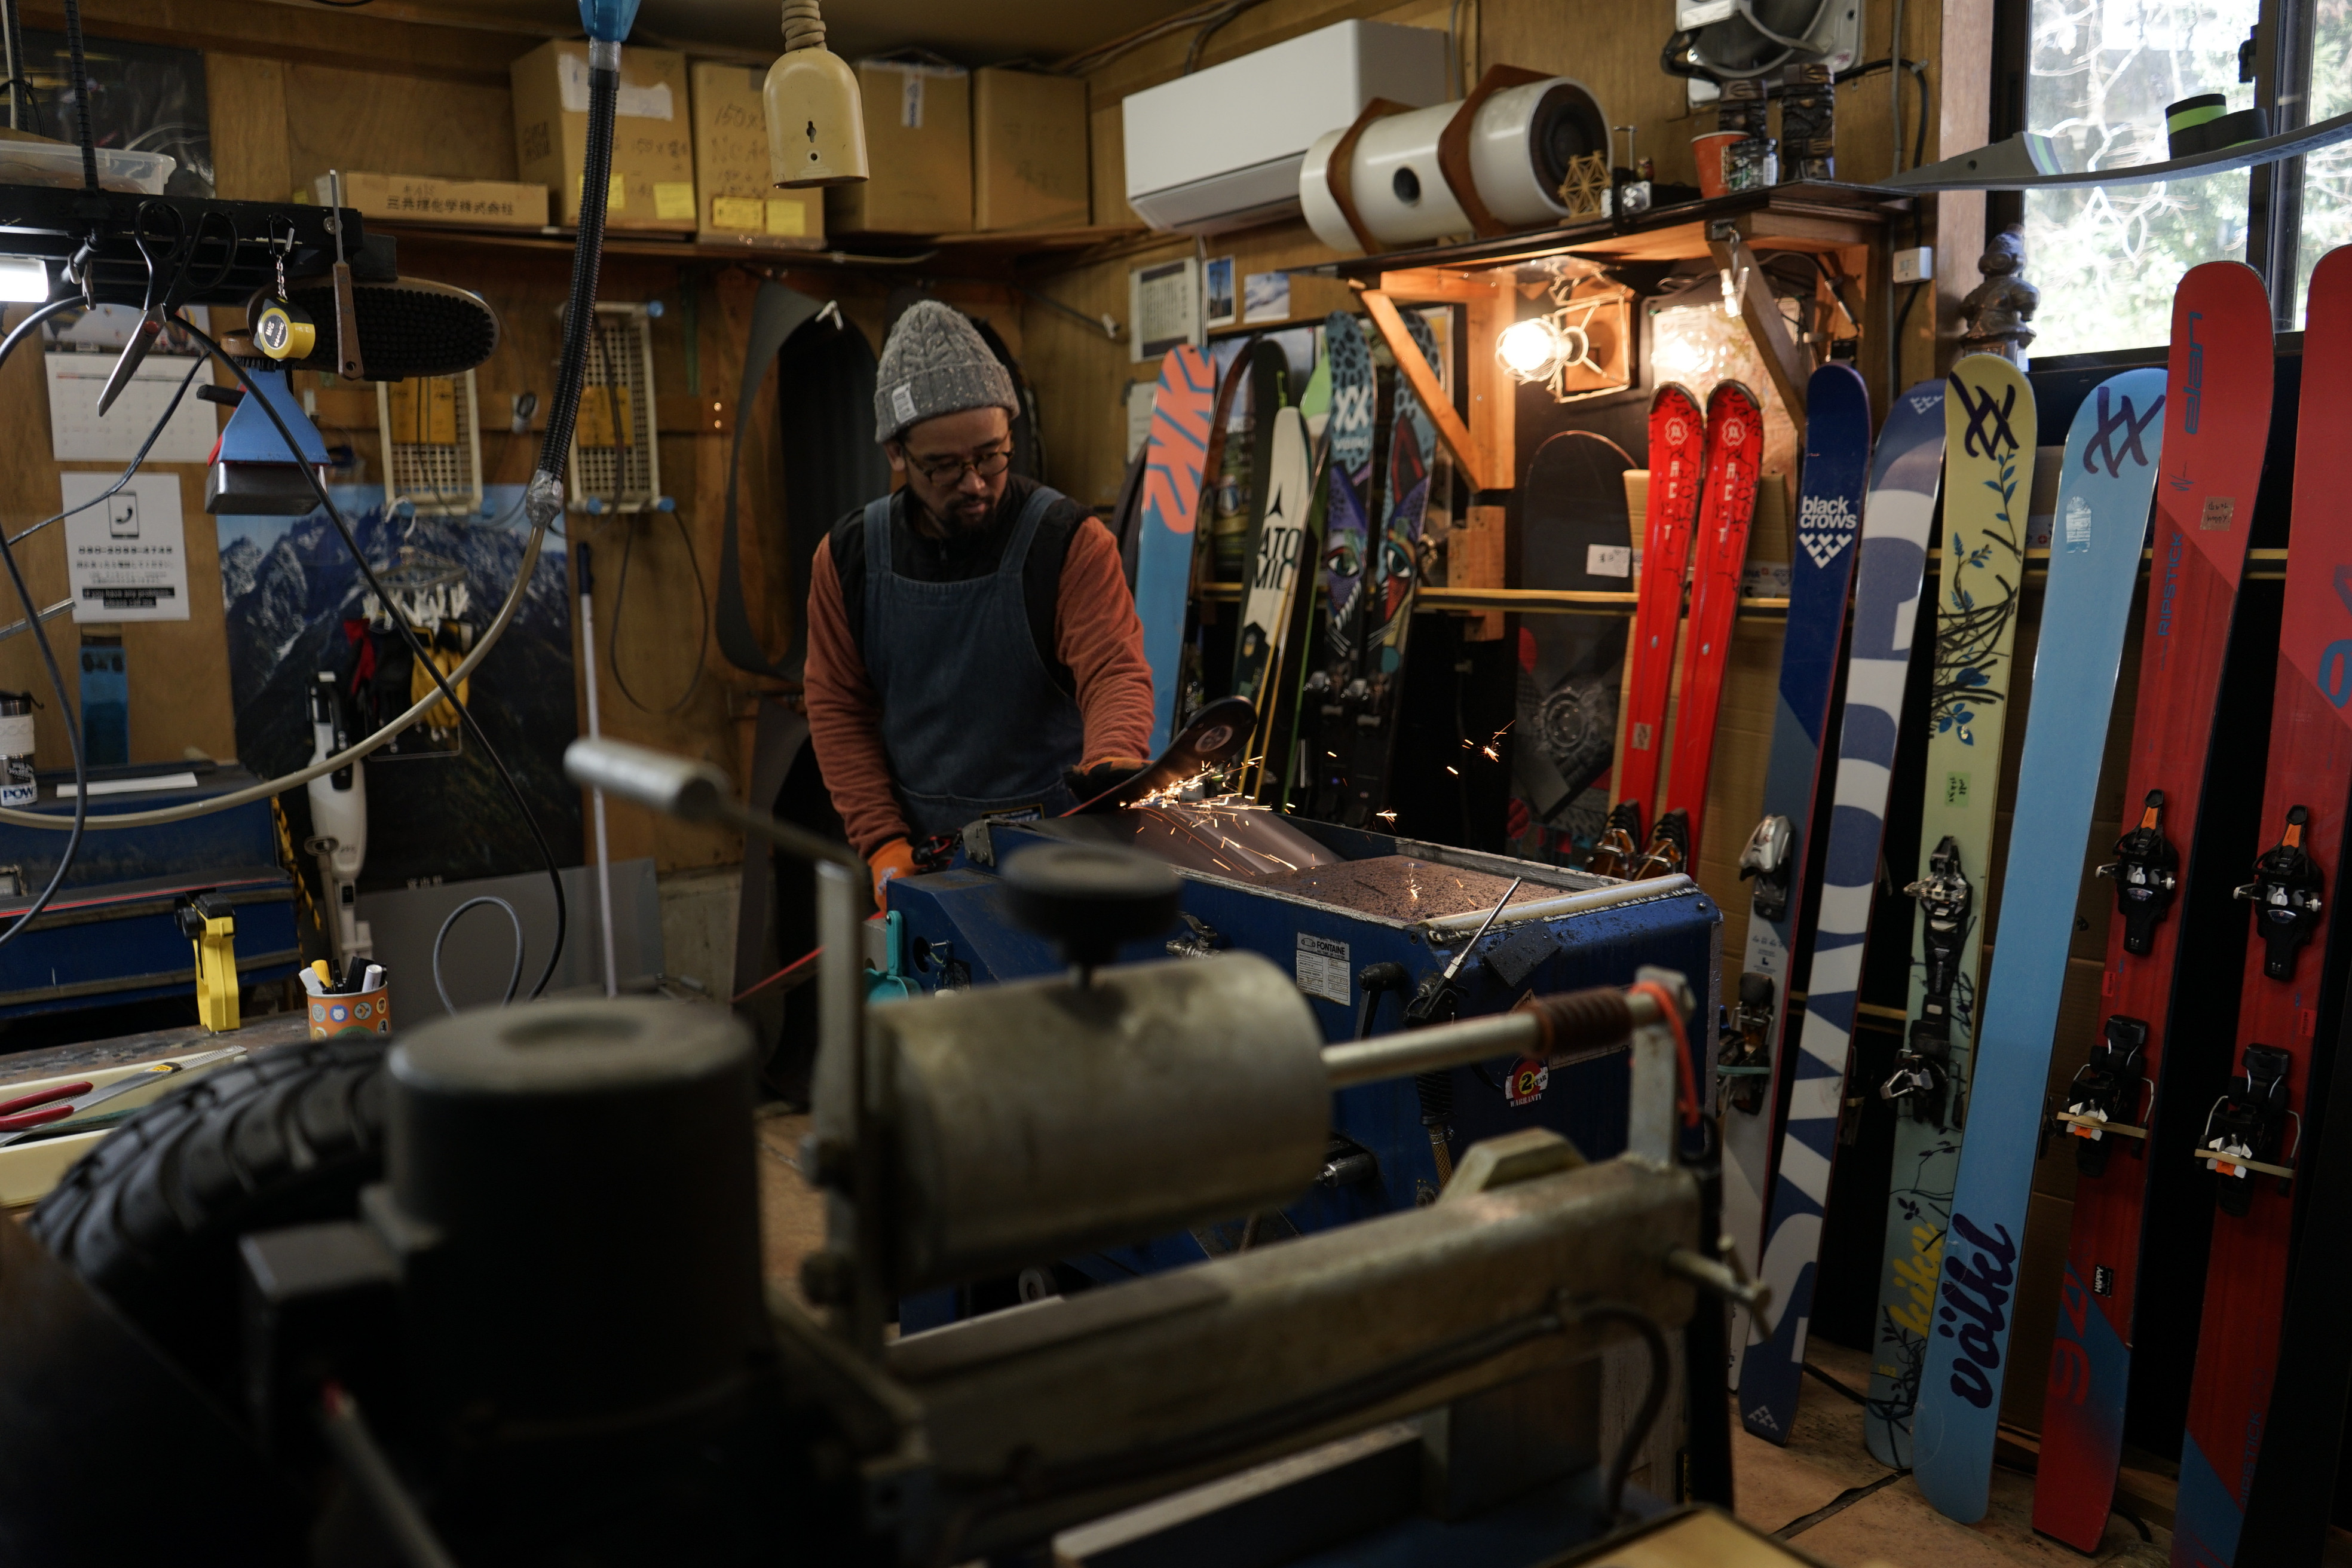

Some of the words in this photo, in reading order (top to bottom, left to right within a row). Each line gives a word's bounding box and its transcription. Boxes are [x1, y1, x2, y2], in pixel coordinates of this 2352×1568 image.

[2184, 311, 2203, 436] elan
[1802, 495, 1850, 514] black
[1800, 513, 1857, 529] crows
[2158, 532, 2183, 636] RIPSTICK
[4, 787, 33, 801] POW
[1316, 941, 1346, 956] FONTAINE
[1521, 1073, 1533, 1092] 2
[1532, 1074, 1546, 1087] YEAR
[1509, 1092, 1543, 1108] WARRANTY
[2094, 1266, 2104, 1293] HAPPY
[1937, 1212, 2016, 1408] völkl
